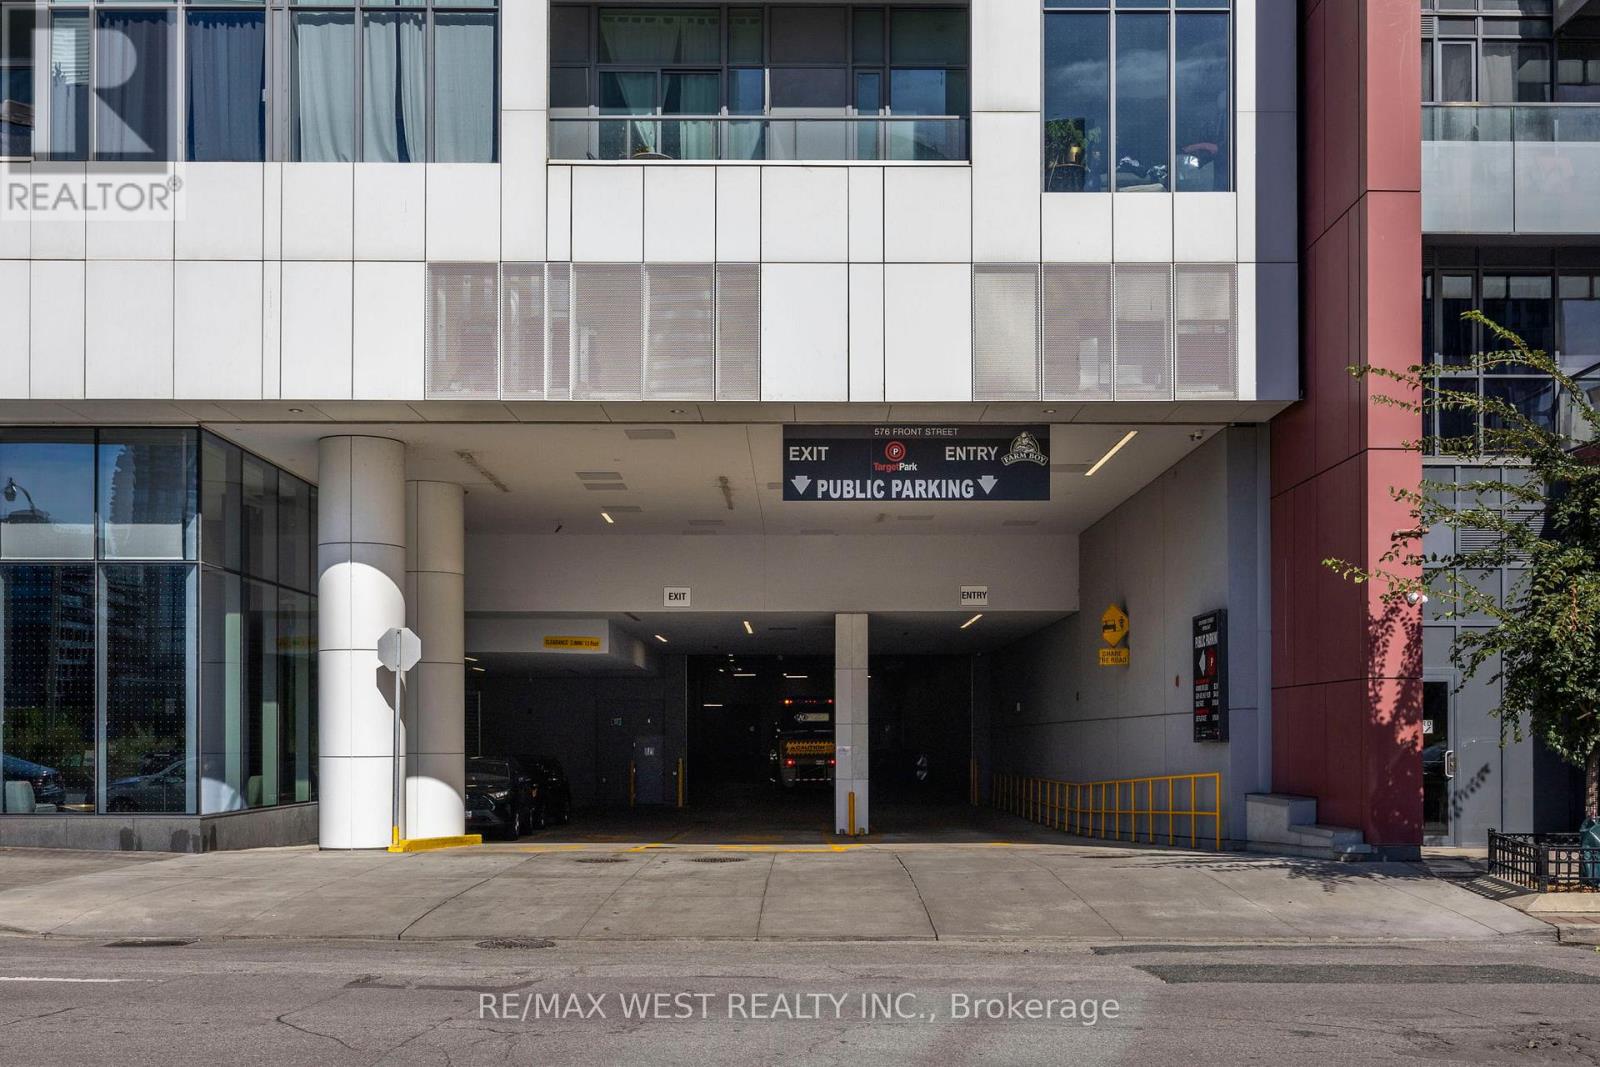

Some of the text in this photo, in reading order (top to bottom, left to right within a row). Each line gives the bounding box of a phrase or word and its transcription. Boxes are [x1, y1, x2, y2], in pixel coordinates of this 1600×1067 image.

[874, 427, 959, 436] 576 FRONT STREET
[789, 446, 829, 461] EXIT
[892, 447, 899, 456] P
[945, 446, 999, 461] ENTRY
[1003, 452, 1046, 463] FARM BOY
[817, 479, 974, 499] PUBLIC PARKING
[668, 592, 687, 601] EXIT
[961, 591, 987, 600] ENTRY
